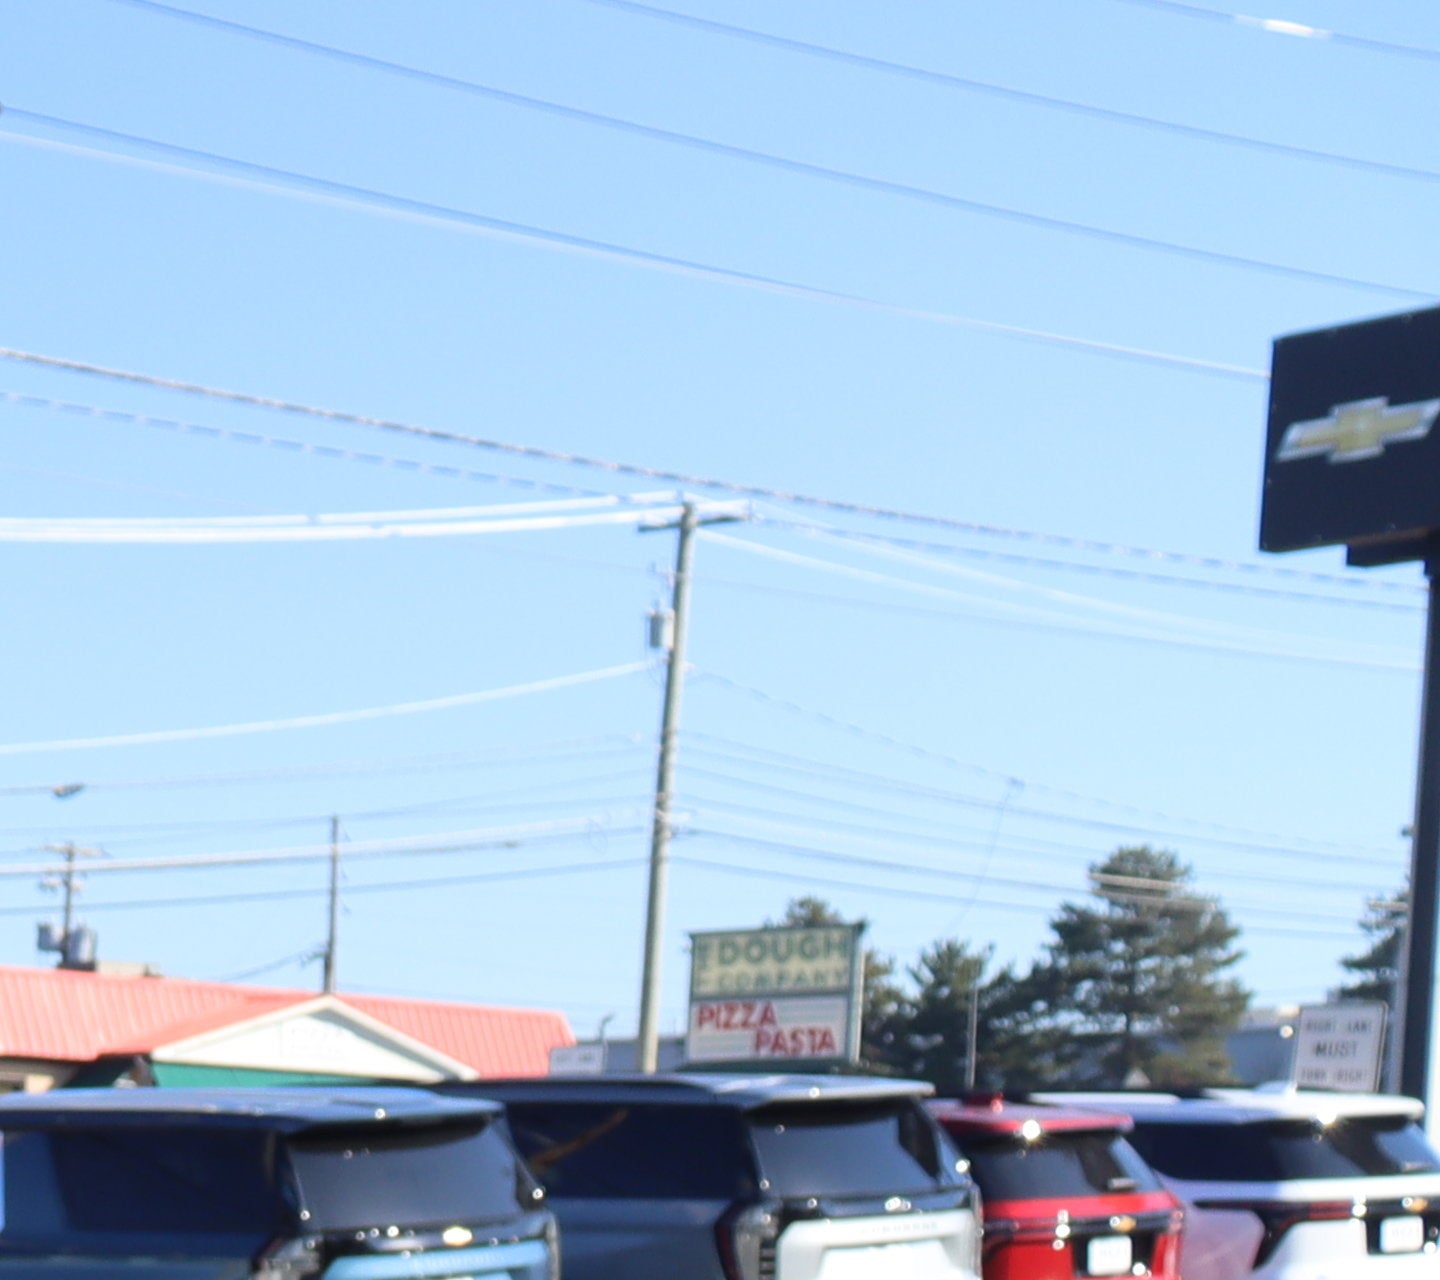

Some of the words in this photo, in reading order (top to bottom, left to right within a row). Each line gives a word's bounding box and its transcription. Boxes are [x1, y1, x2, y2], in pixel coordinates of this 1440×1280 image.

[717, 933, 849, 966] DOUGH
[697, 1000, 778, 1030] PIZZA
[754, 1027, 837, 1055] PASTA
[1314, 1040, 1359, 1057] MUST
